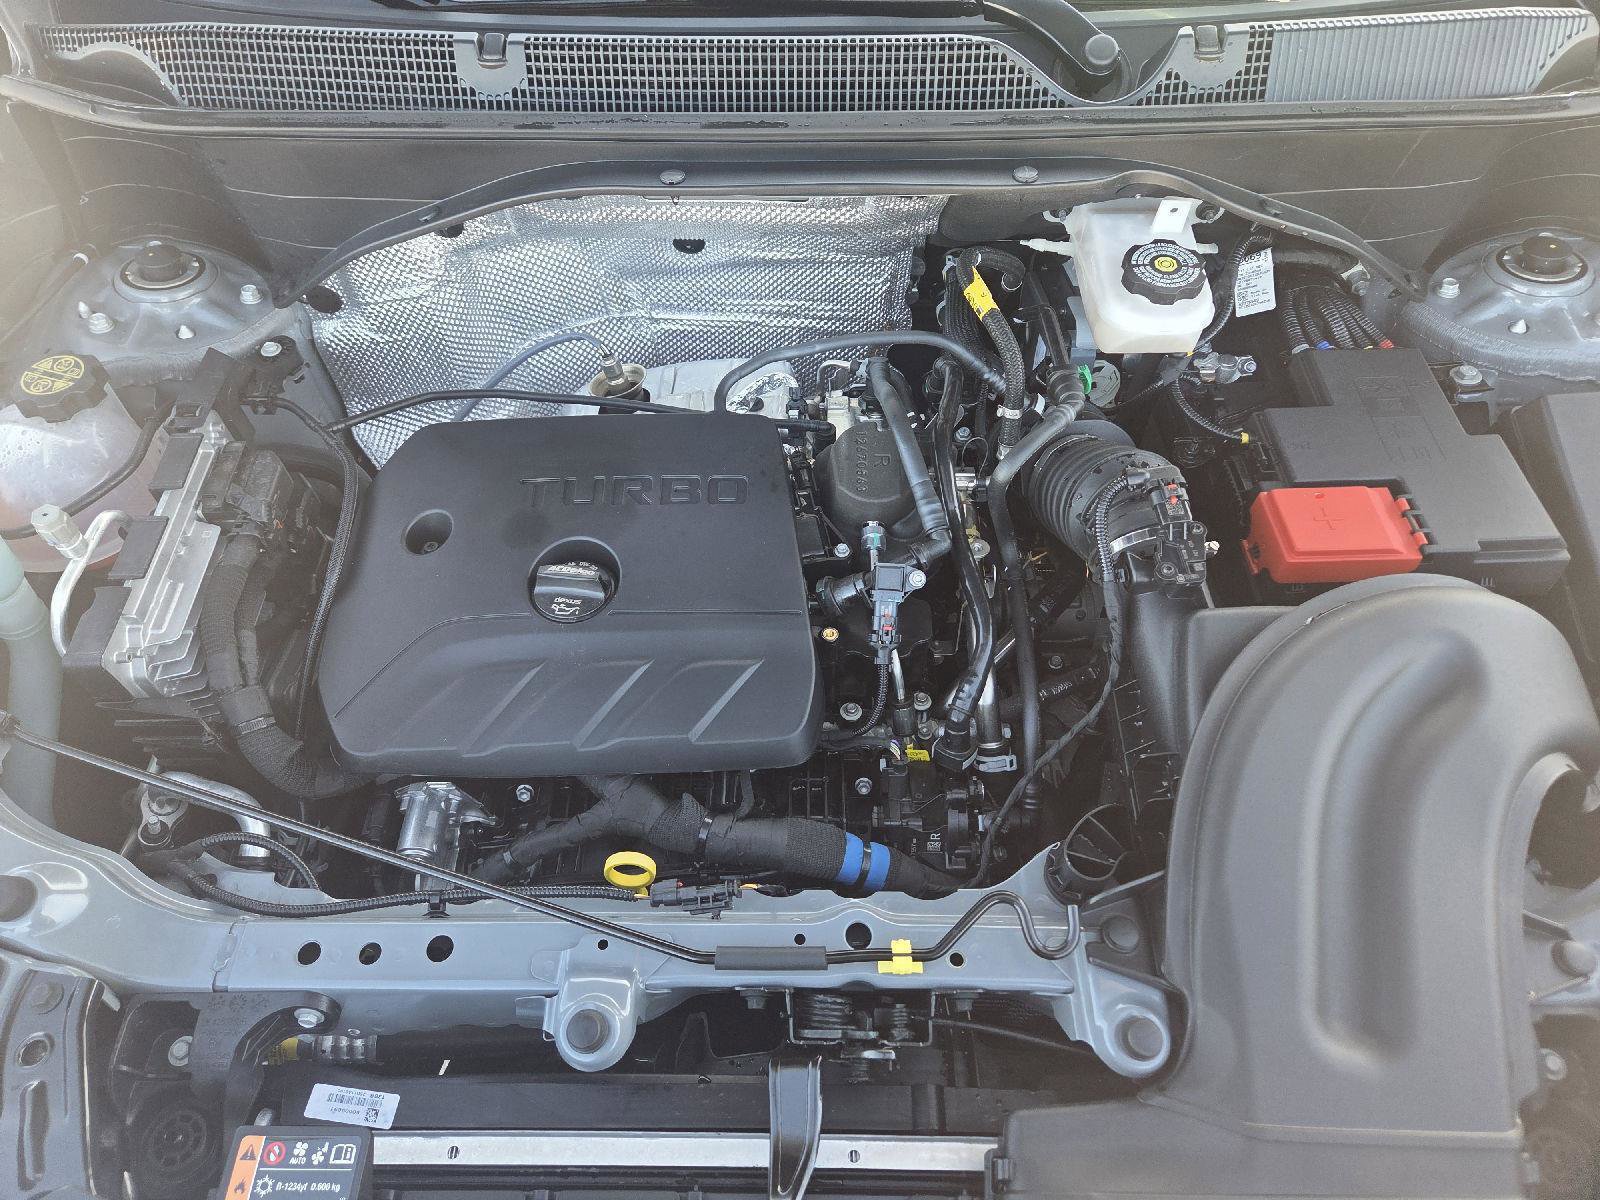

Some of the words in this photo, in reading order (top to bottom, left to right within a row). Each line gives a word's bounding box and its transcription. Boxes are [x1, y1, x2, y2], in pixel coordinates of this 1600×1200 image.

[873, 453, 891, 468] R
[520, 474, 748, 505] TURBO
[289, 1157, 306, 1165] AUTO
[276, 1182, 308, 1192] R-1234yf
[331, 1182, 341, 1193] kg
